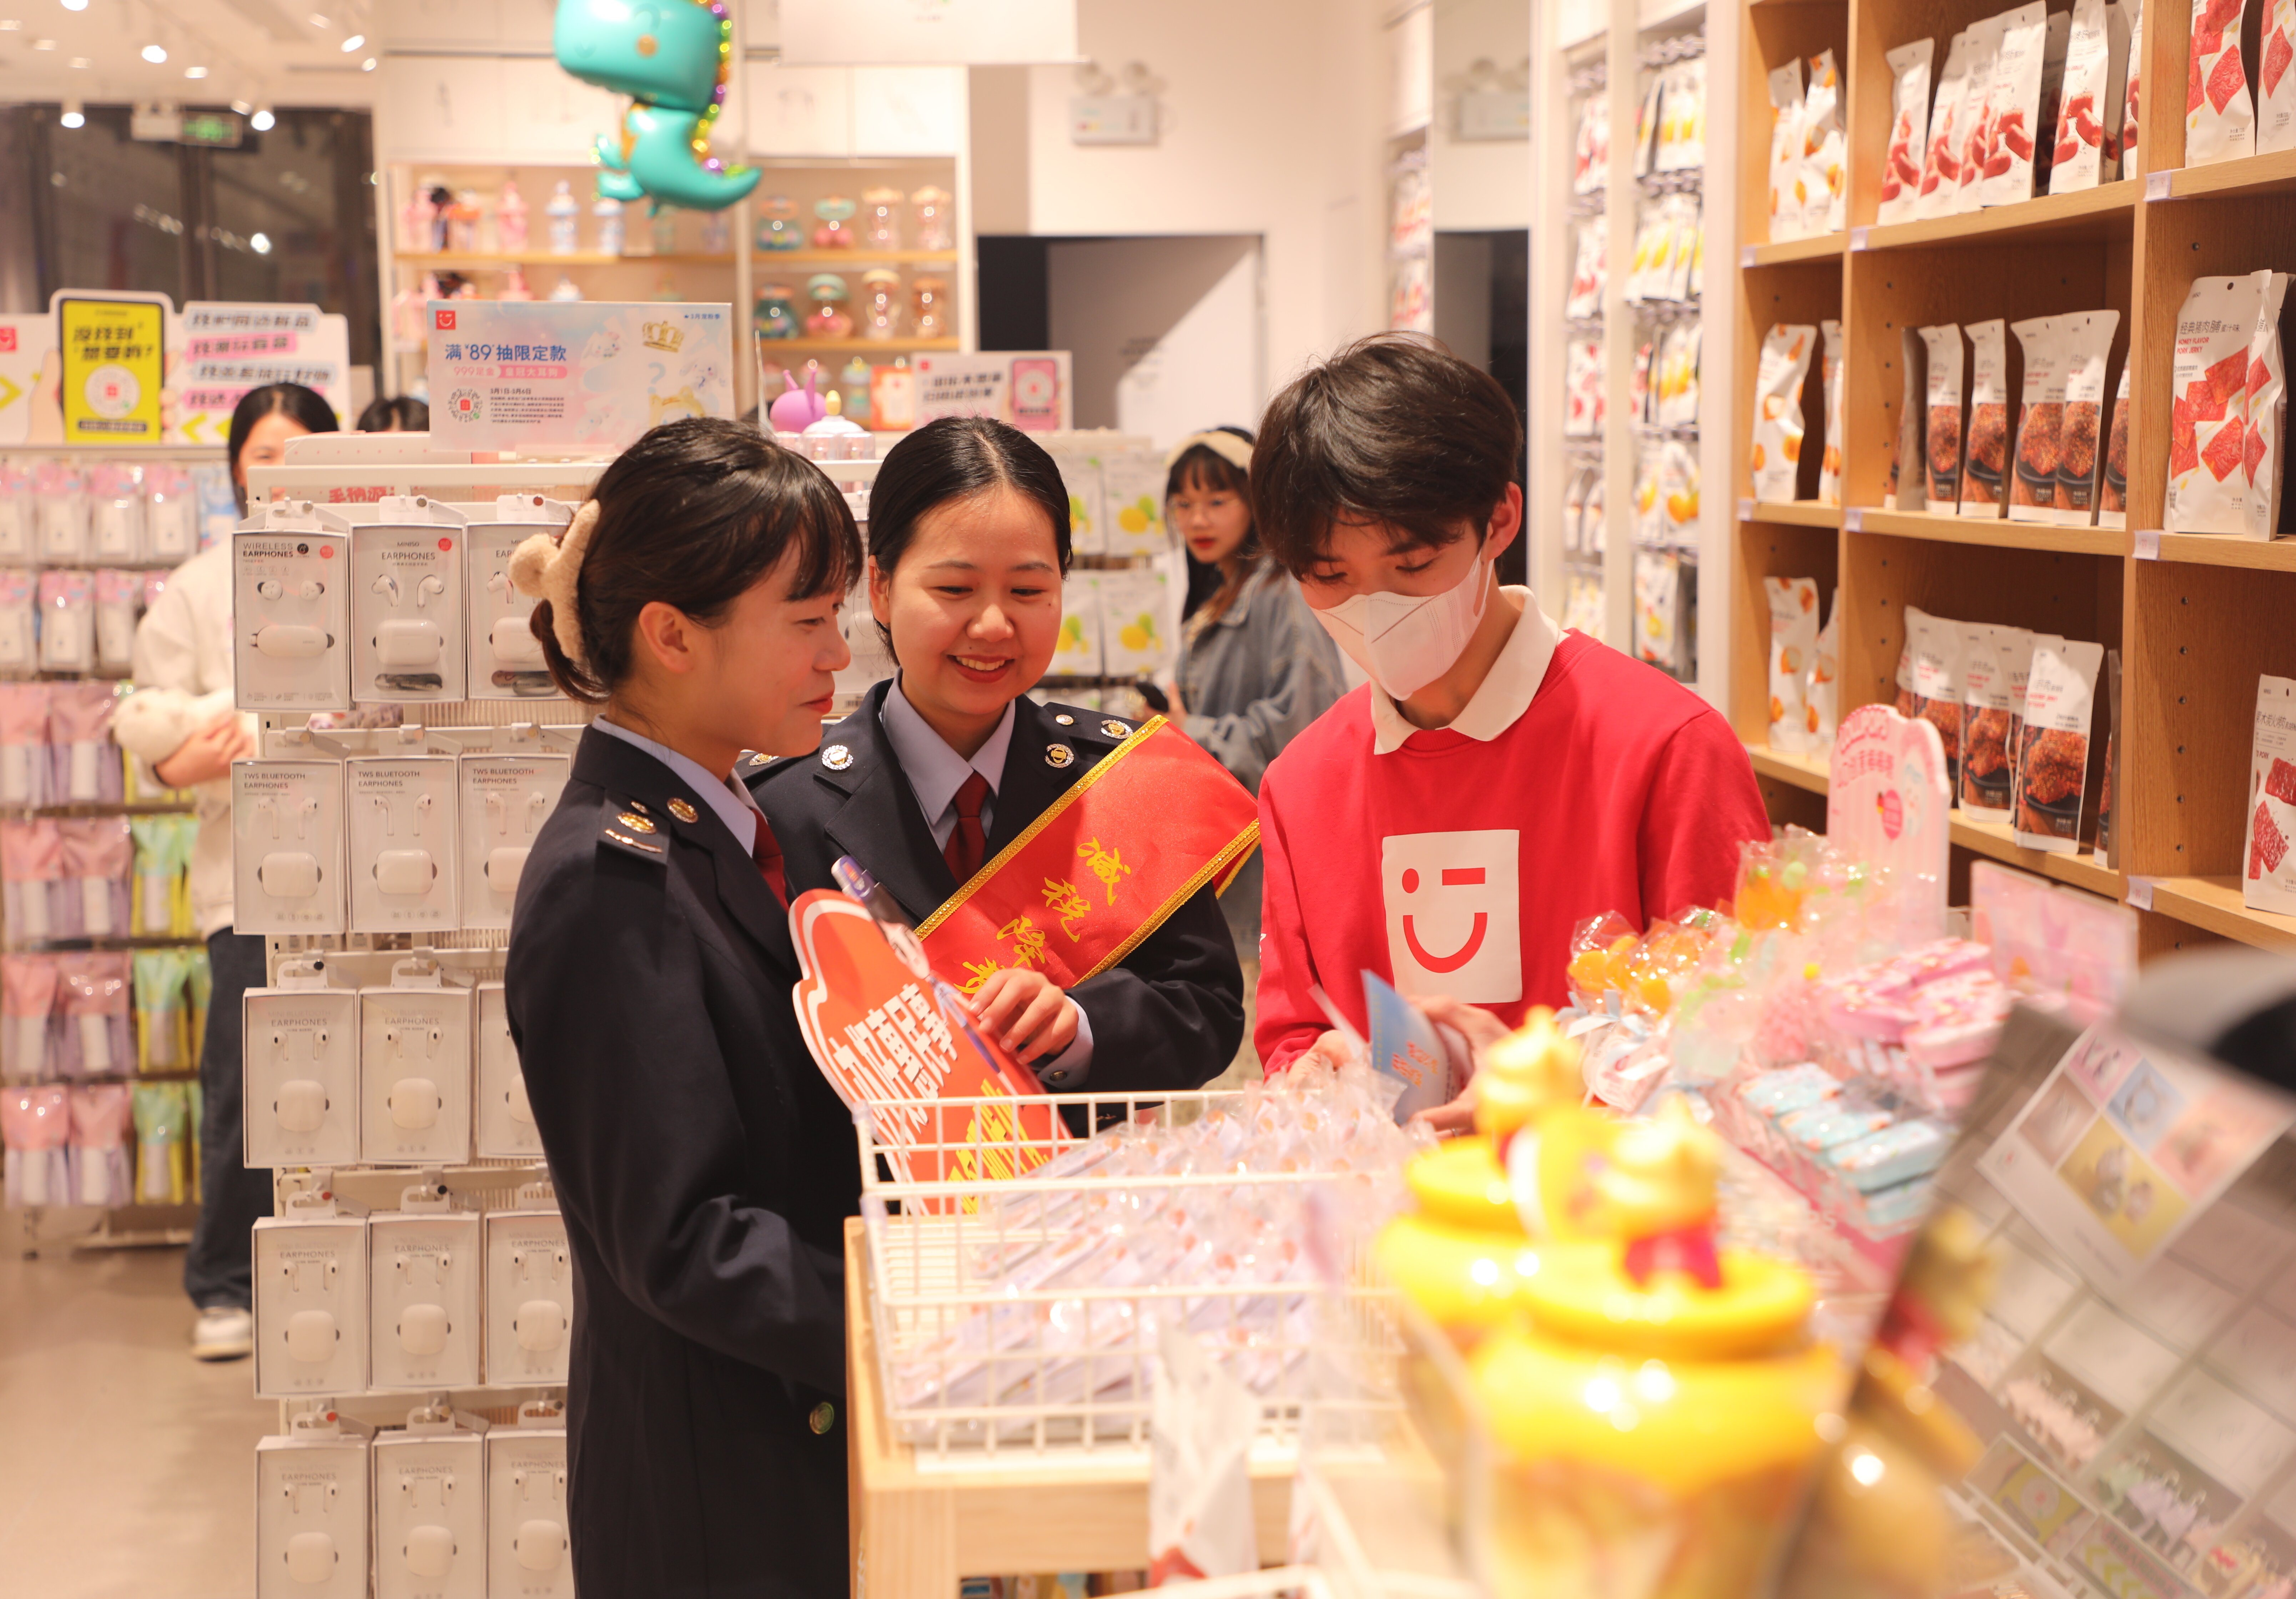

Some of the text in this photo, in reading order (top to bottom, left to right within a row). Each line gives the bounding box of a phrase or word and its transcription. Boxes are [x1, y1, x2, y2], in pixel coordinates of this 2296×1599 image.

[382, 552, 435, 560] EARPHONES
[271, 1018, 327, 1027] EARPHONES
[280, 1250, 335, 1258] EARPHONES
